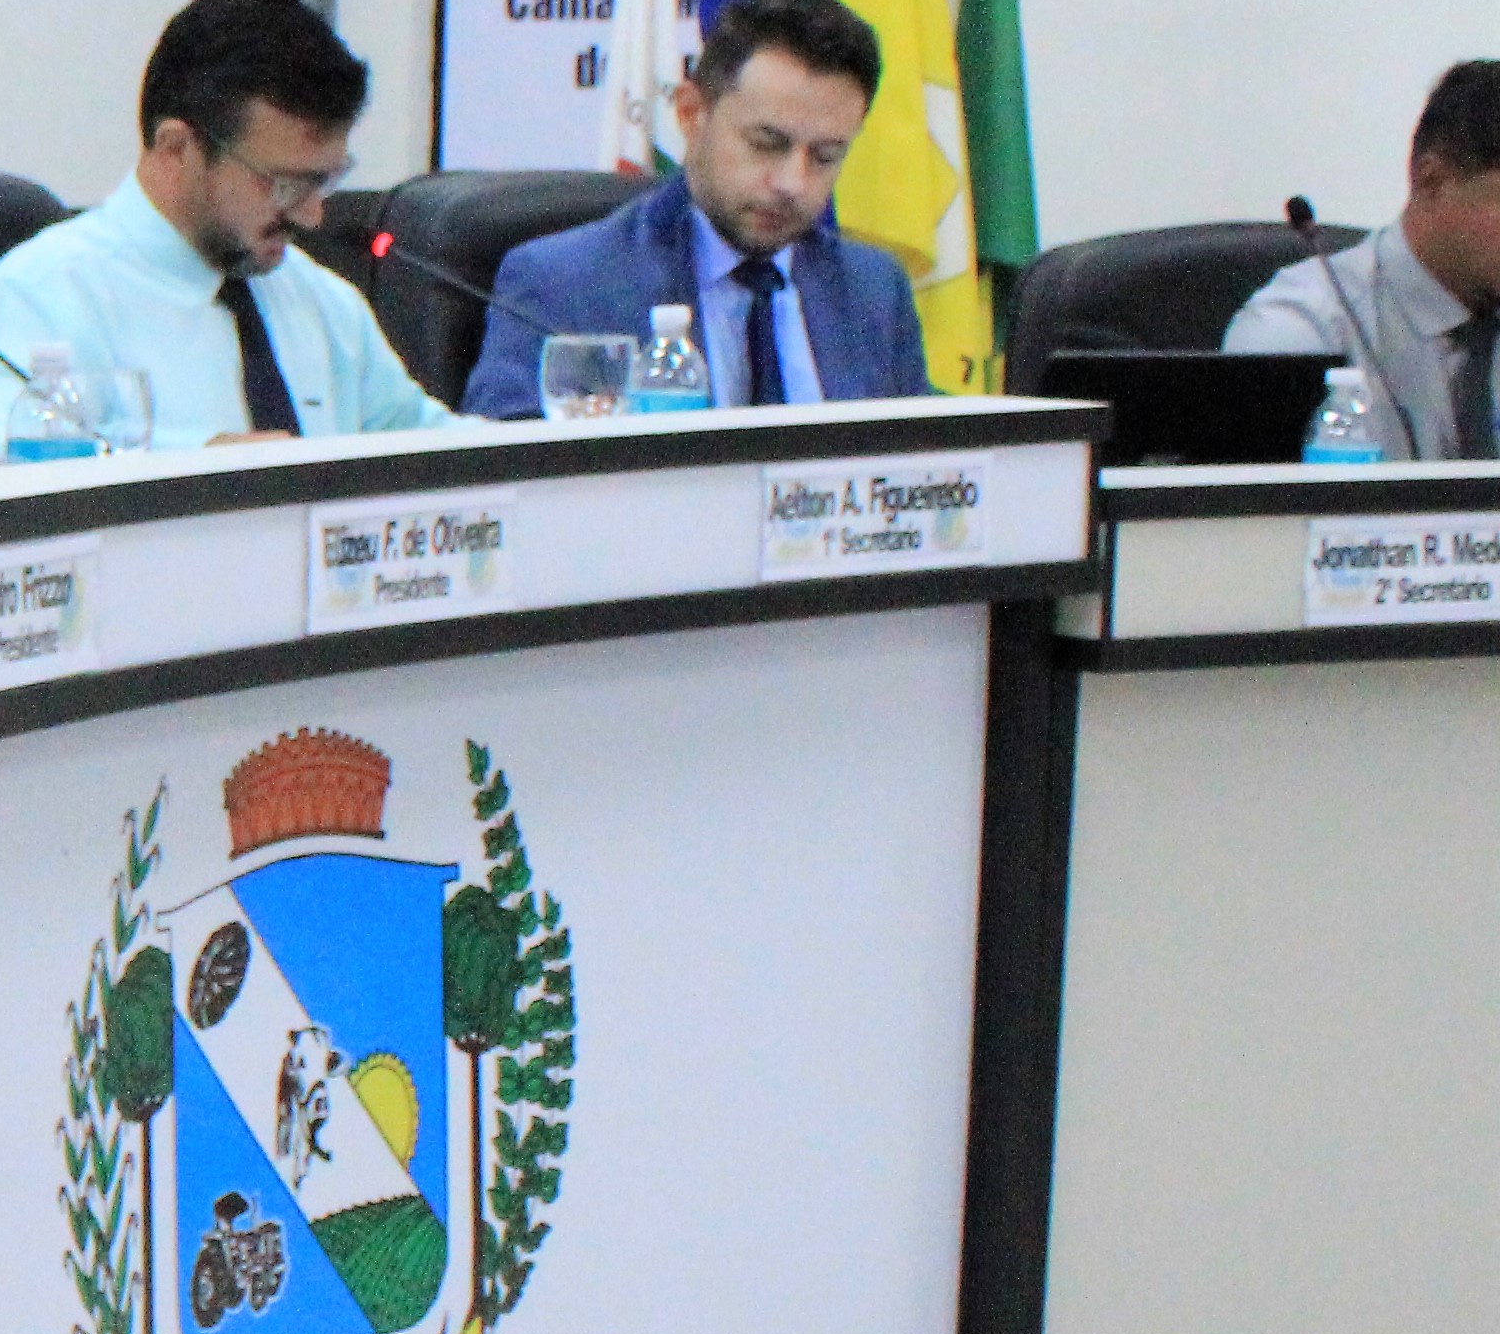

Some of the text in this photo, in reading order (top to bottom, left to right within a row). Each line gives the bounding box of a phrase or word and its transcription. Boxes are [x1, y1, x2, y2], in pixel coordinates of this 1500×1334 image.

[839, 478, 861, 515] A.
[868, 472, 979, 523] Figueiredo
[383, 520, 399, 560] F.
[402, 519, 426, 557] de
[430, 513, 501, 555] Oliveira
[1424, 534, 1446, 566] R.
[373, 571, 450, 604] Presidente
